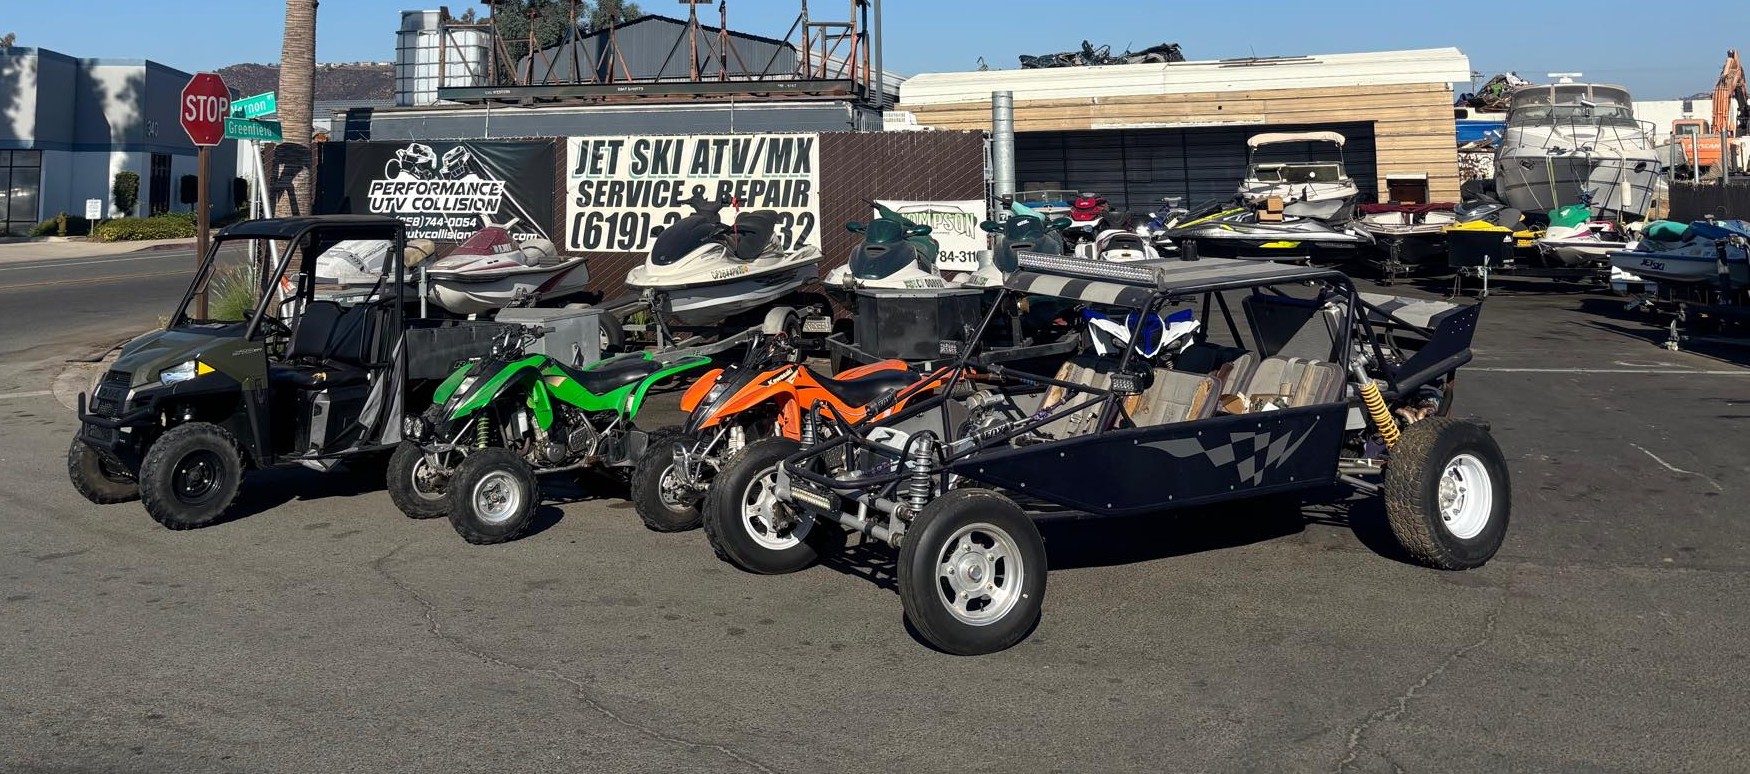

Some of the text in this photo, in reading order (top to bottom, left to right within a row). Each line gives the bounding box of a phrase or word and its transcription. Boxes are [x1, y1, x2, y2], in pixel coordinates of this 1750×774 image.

[185, 95, 228, 123] STOP
[228, 120, 272, 137] Greenfield
[573, 137, 813, 177] JET SKI ATV/MX
[370, 181, 504, 197] PERFORMANCE
[575, 179, 685, 208] SERVICE
[716, 179, 811, 208] REPAIR
[371, 197, 501, 213] UTV COLLISION
[395, 215, 477, 228] 58)744-0054
[570, 211, 650, 251] (619)
[903, 211, 976, 240] OMPSON
[939, 250, 979, 263] 84-311
[768, 367, 794, 386] Kawasaki
